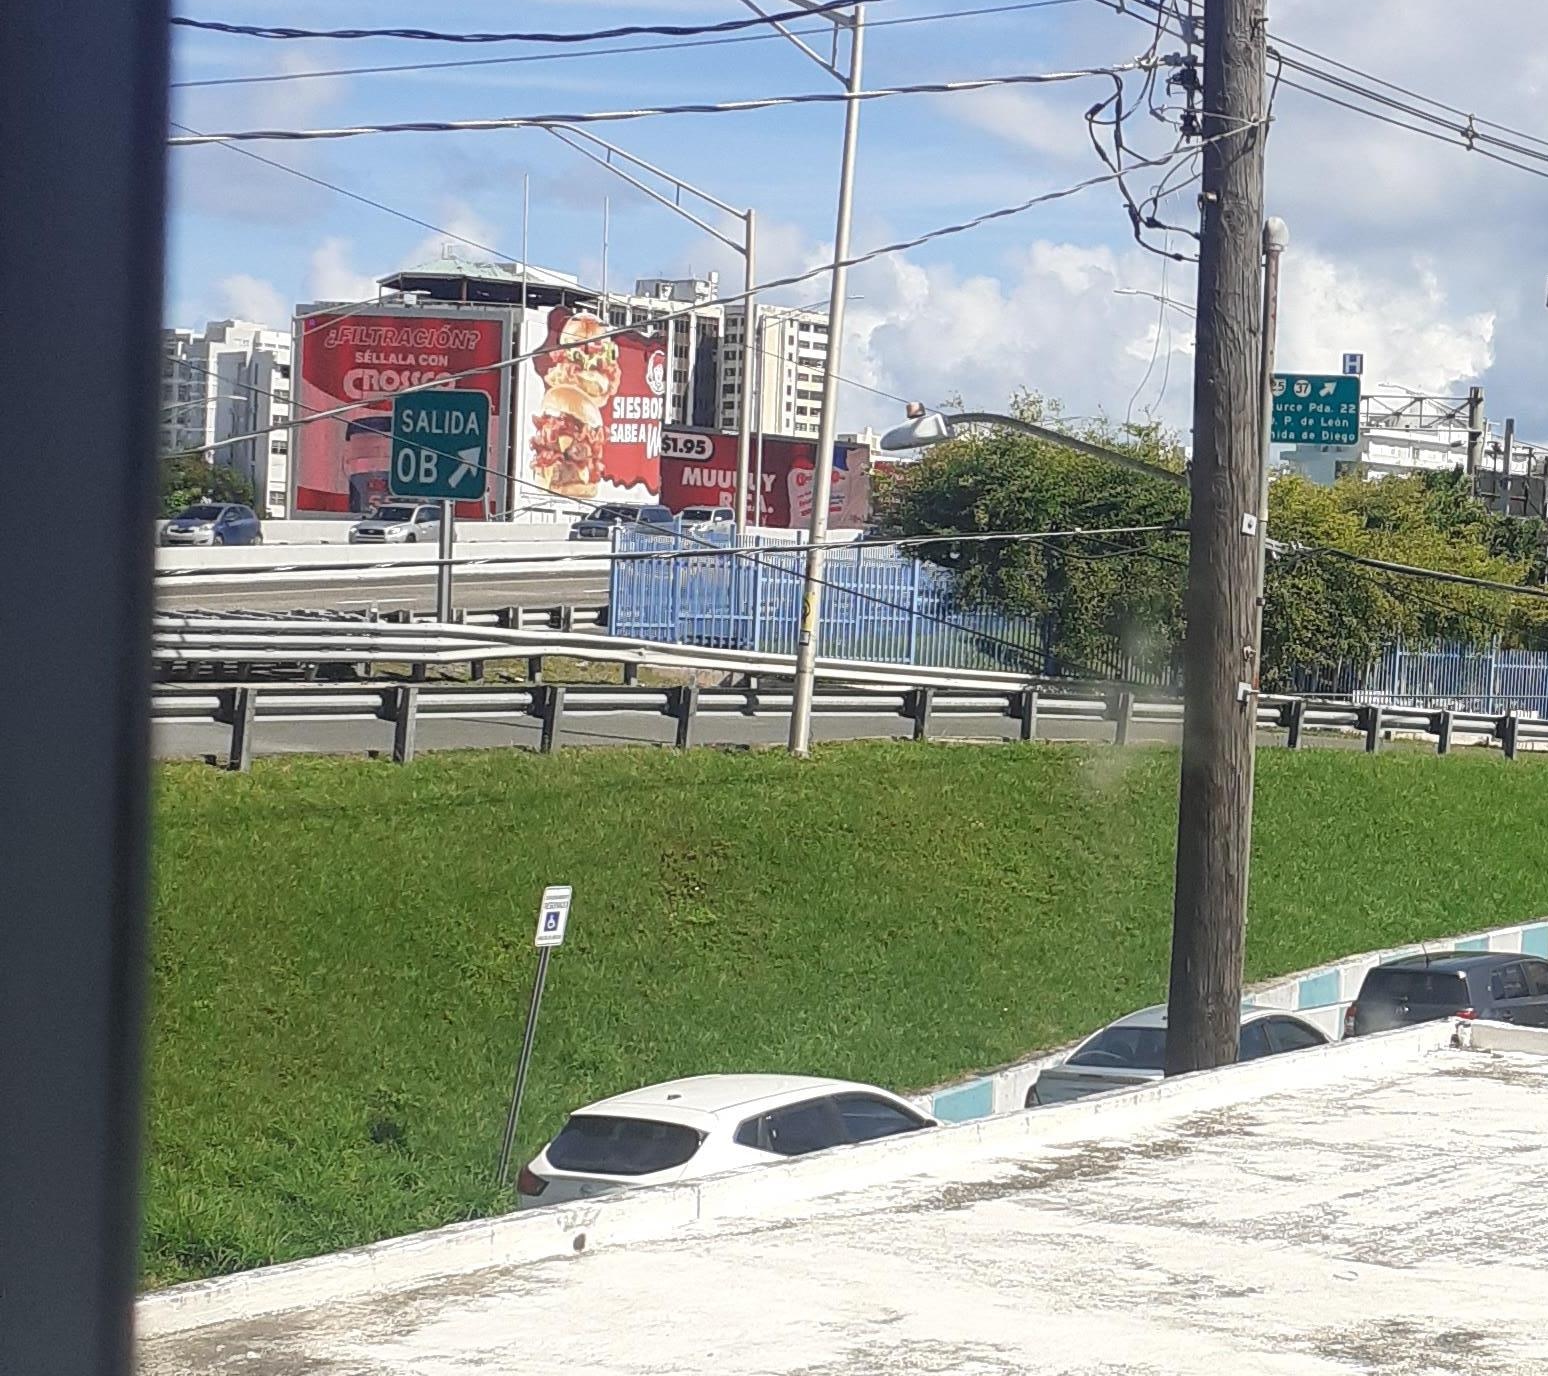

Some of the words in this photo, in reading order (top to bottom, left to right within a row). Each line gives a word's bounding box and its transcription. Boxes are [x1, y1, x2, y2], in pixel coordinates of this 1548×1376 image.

[325, 325, 481, 350] ¿FILTRACIÓN?
[355, 351, 416, 366] SÉLLALA
[418, 355, 448, 368] CON
[1295, 382, 1309, 394] 37
[612, 396, 625, 419] SI
[626, 396, 641, 420] ES
[1271, 403, 1303, 412] urce
[1308, 402, 1334, 413] Pda.
[1340, 404, 1357, 414] 22
[402, 408, 480, 436] SALIDA
[1301, 416, 1315, 426] de
[1321, 417, 1349, 428] León
[610, 422, 639, 443] SABE
[638, 423, 647, 443] A
[1271, 430, 1296, 440] nida
[1301, 431, 1316, 440] de
[1321, 430, 1356, 443] Diego
[661, 434, 706, 455] $1.95
